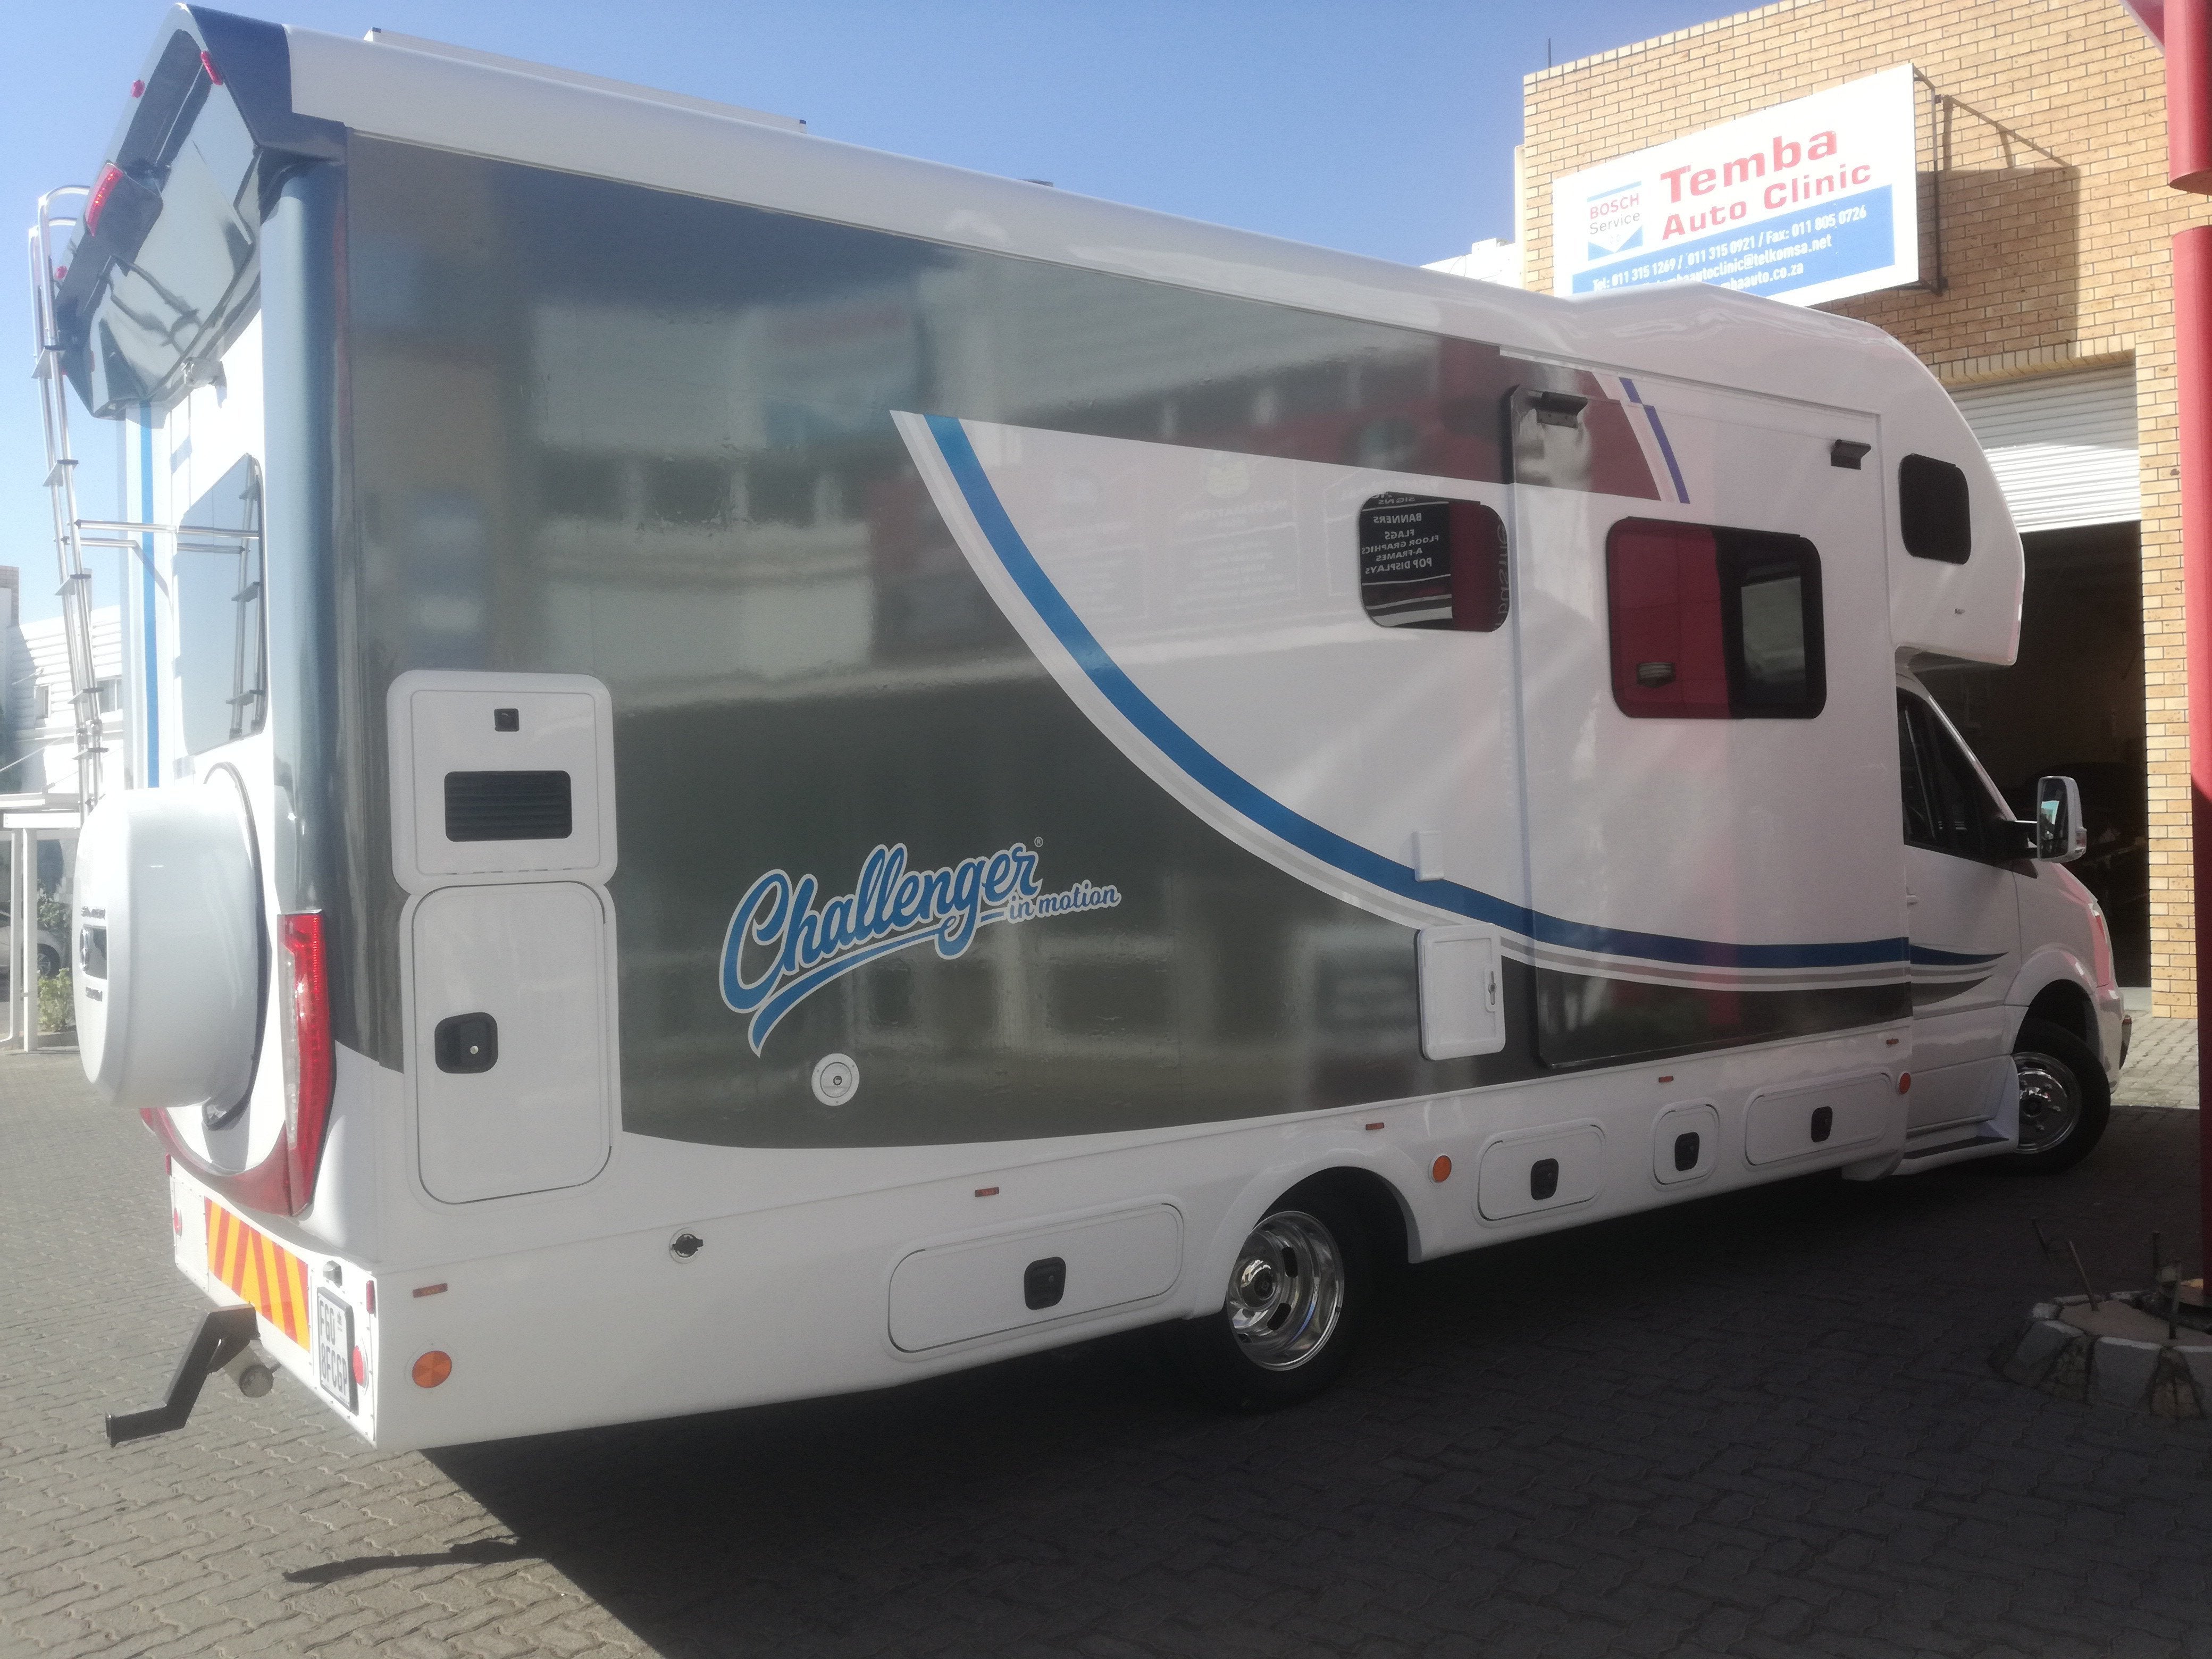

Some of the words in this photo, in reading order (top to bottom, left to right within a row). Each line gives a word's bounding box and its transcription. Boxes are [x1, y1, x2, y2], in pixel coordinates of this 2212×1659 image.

[1660, 130, 1838, 204] Temba
[1662, 198, 1747, 241] Auto
[1764, 164, 1872, 210] Clinic
[1589, 212, 1640, 235] Service
[1590, 192, 1639, 220] BOSCH
[1592, 277, 1610, 291] Tel:
[1612, 271, 1629, 287] 011
[1631, 265, 1649, 281] 315
[1652, 257, 1675, 274] 1269
[1688, 250, 1706, 266] 011
[1708, 243, 1728, 259] 315
[1730, 236, 1755, 254] 0921
[1766, 230, 1790, 245] Fax:
[1792, 220, 1811, 237] 011
[1815, 213, 1836, 231] 805
[1838, 205, 1867, 224] 0726
[719, 843, 1043, 1013] Challenger
[1009, 892, 1036, 922] in
[1037, 881, 1121, 916] motion
